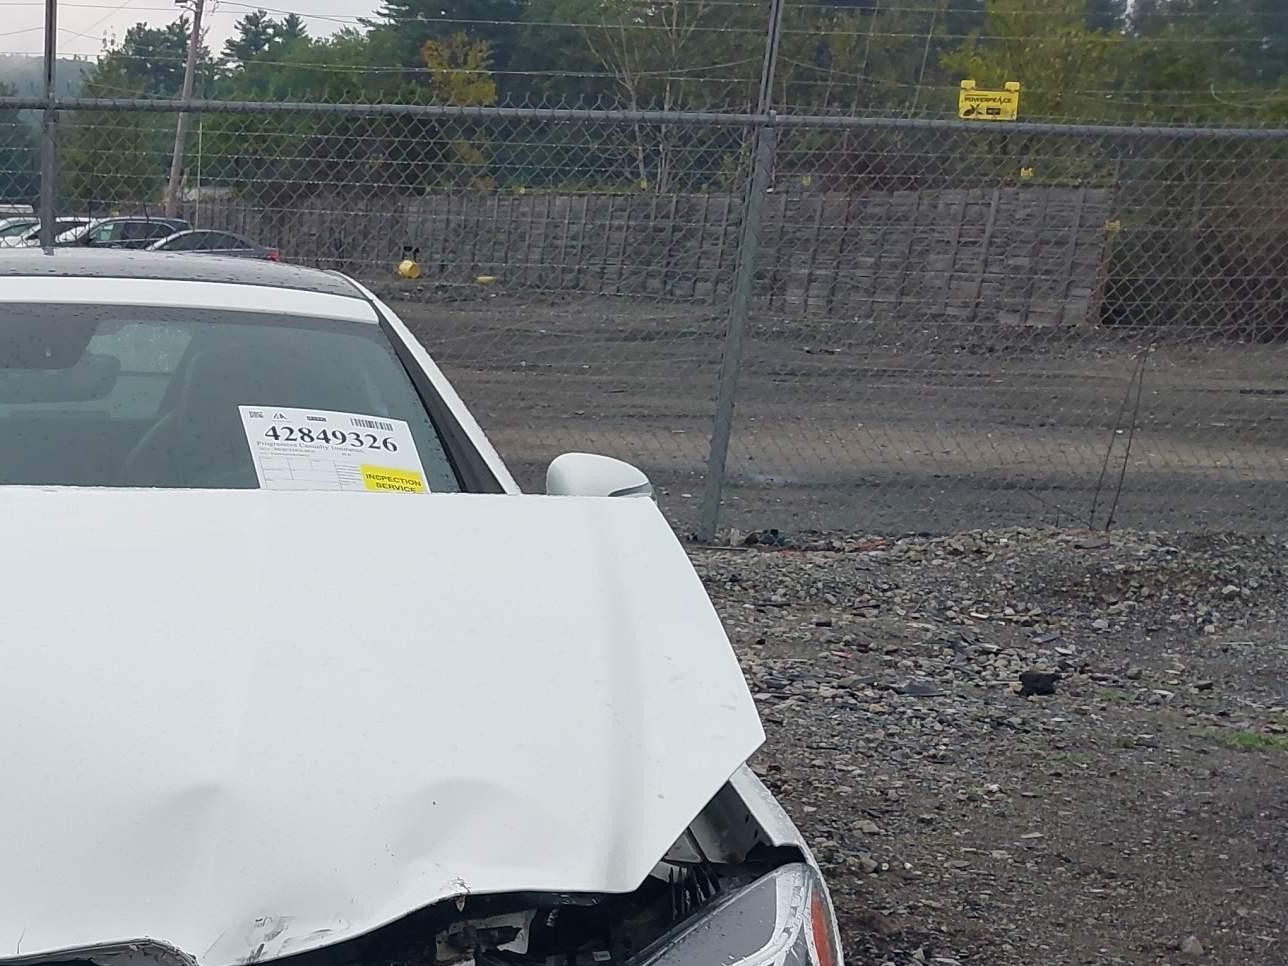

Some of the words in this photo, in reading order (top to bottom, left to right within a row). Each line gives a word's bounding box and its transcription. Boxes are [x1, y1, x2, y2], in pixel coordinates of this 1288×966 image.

[264, 425, 399, 453] 42849326
[365, 473, 421, 487] INSPECTION
[375, 482, 416, 493] SERVICE
